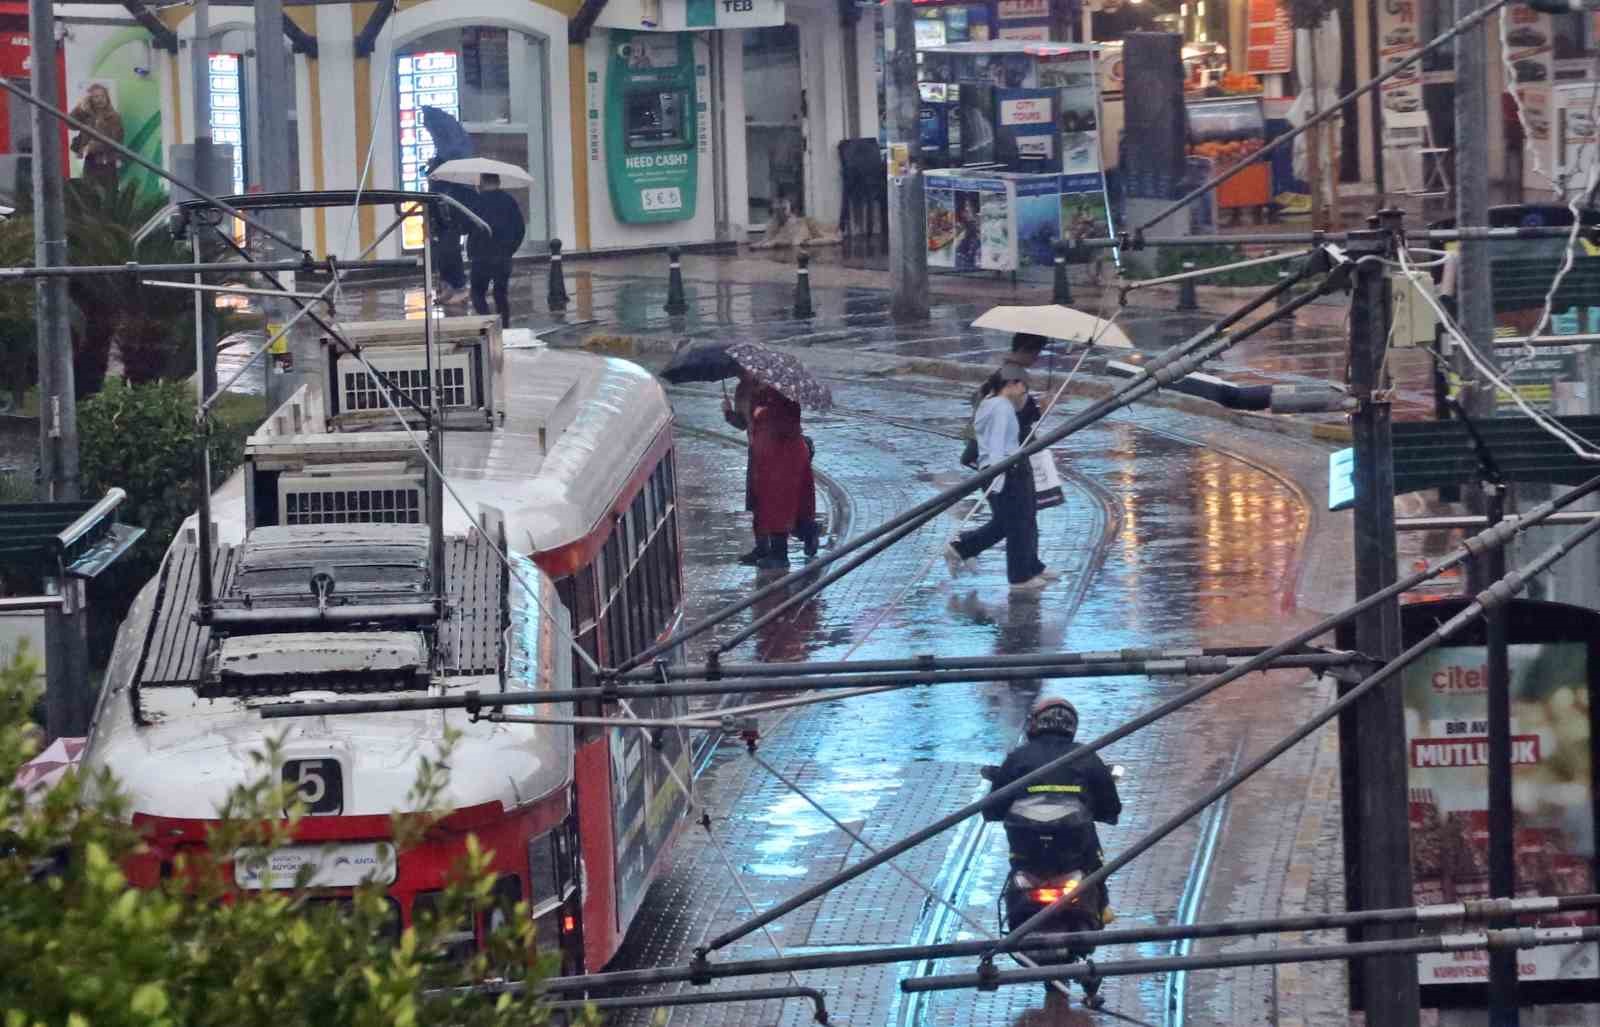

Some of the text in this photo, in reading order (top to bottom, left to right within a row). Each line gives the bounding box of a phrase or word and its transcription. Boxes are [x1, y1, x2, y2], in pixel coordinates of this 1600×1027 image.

[722, 0, 753, 13] TEB
[626, 153, 688, 168] NEED CASH?
[1471, 721, 1488, 733] AV
[299, 761, 326, 803] 5
